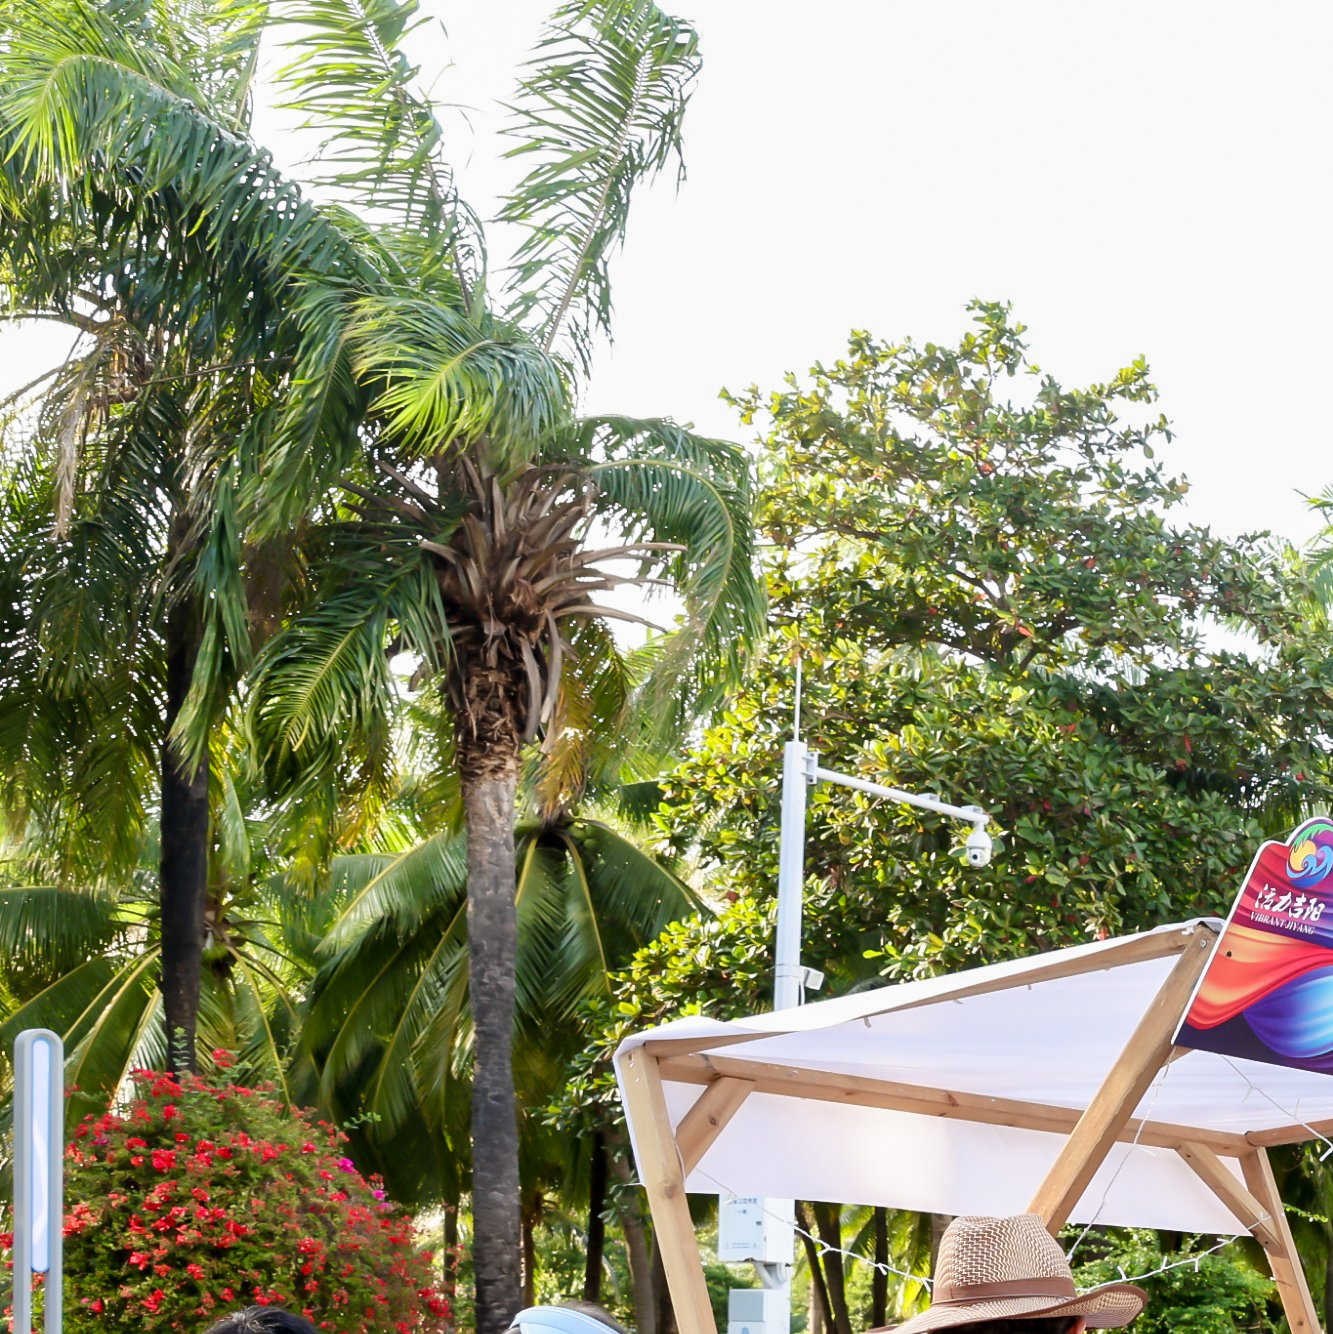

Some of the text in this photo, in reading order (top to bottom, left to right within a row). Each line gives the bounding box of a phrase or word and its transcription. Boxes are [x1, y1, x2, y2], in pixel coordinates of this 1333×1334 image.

[1254, 883, 1326, 922] 活力吉阳
[1249, 911, 1316, 935] VIBRANT JIYANG
